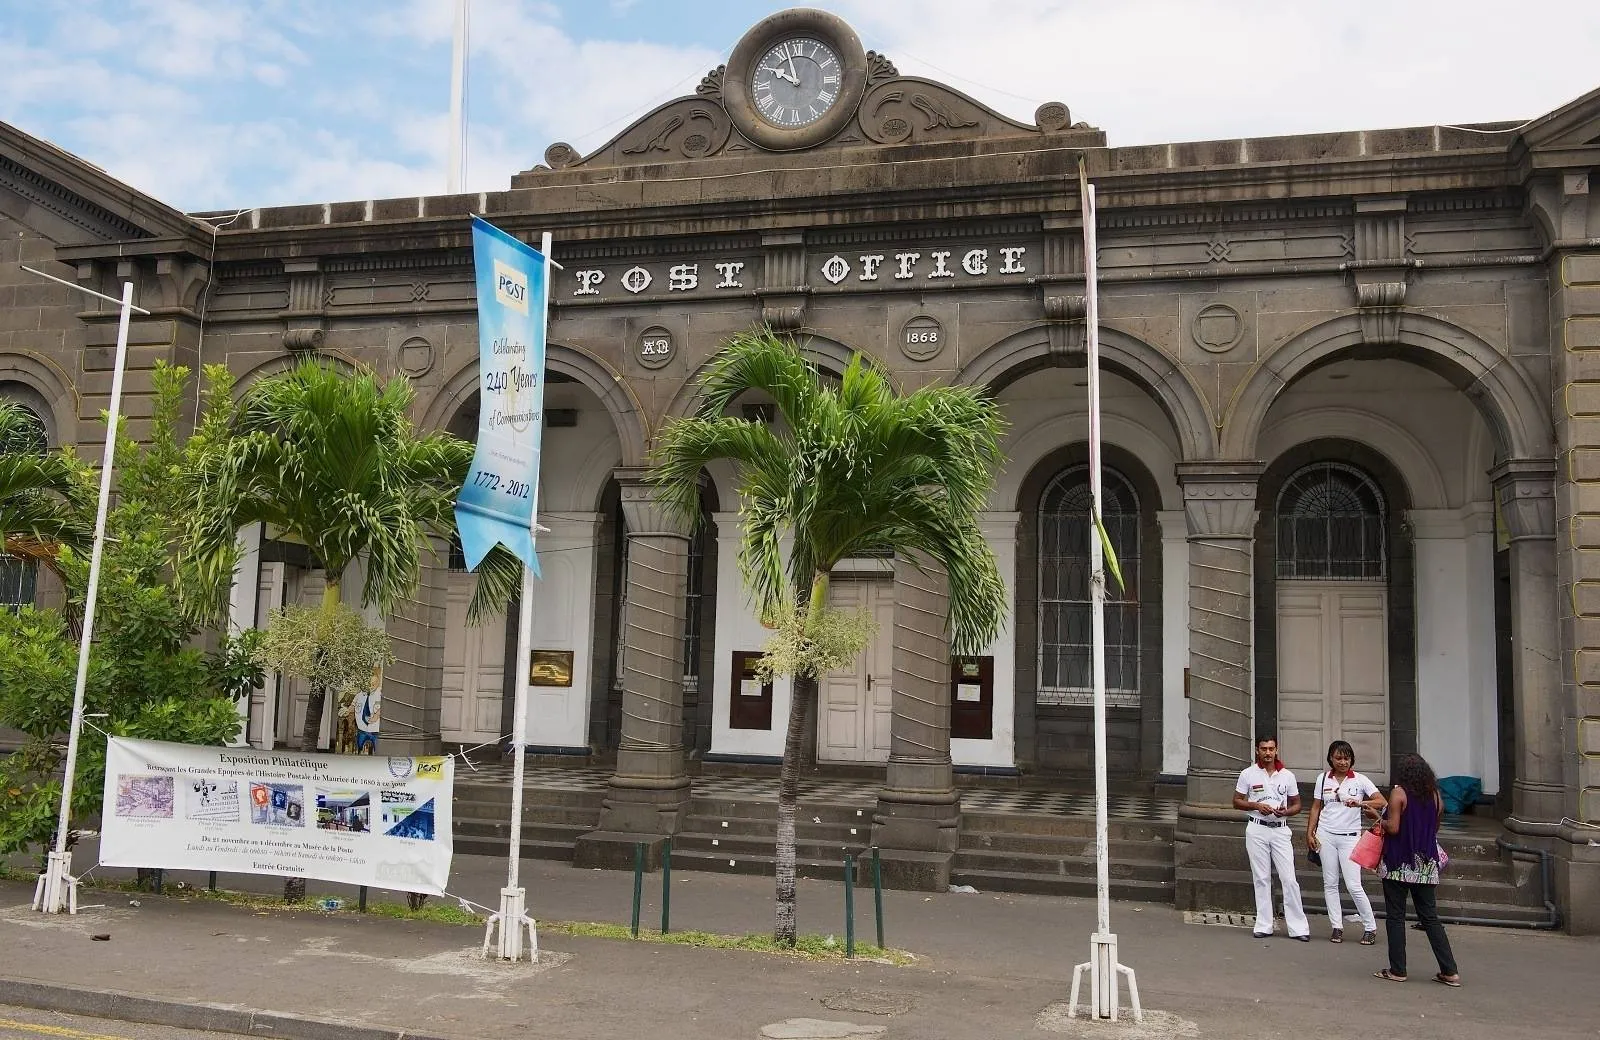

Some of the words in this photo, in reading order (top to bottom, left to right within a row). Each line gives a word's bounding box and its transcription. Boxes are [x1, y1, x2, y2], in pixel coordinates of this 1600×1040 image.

[792, 43, 804, 57] XII
[820, 58, 833, 69] II
[824, 75, 837, 84] III
[573, 262, 745, 296] POST
[821, 246, 1026, 285] OFFICE
[499, 275, 525, 301] POST
[906, 332, 938, 344] 1868
[641, 339, 670, 355] AD
[486, 371, 508, 395] 240
[510, 364, 538, 393] Years
[489, 409, 496, 430] of
[473, 470, 501, 491] 1772
[505, 479, 530, 499] 2012
[219, 753, 269, 766] Exposition
[271, 756, 329, 771] Philatélique
[417, 763, 442, 773] POST
[188, 766, 215, 775] Grandes
[217, 767, 244, 777] Epopées
[255, 770, 285, 779] l'Histoire
[287, 772, 310, 780] Postale
[322, 774, 348, 783] Maurice
[350, 776, 358, 784] de
[214, 845, 238, 853] Vendredi
[221, 837, 249, 845] novembre
[266, 839, 292, 848] décembre
[302, 842, 321, 851] Musée
[322, 844, 330, 852] de
[337, 846, 354, 854] Poste
[253, 861, 274, 871] Entrée
[276, 863, 305, 873] Gratuite
